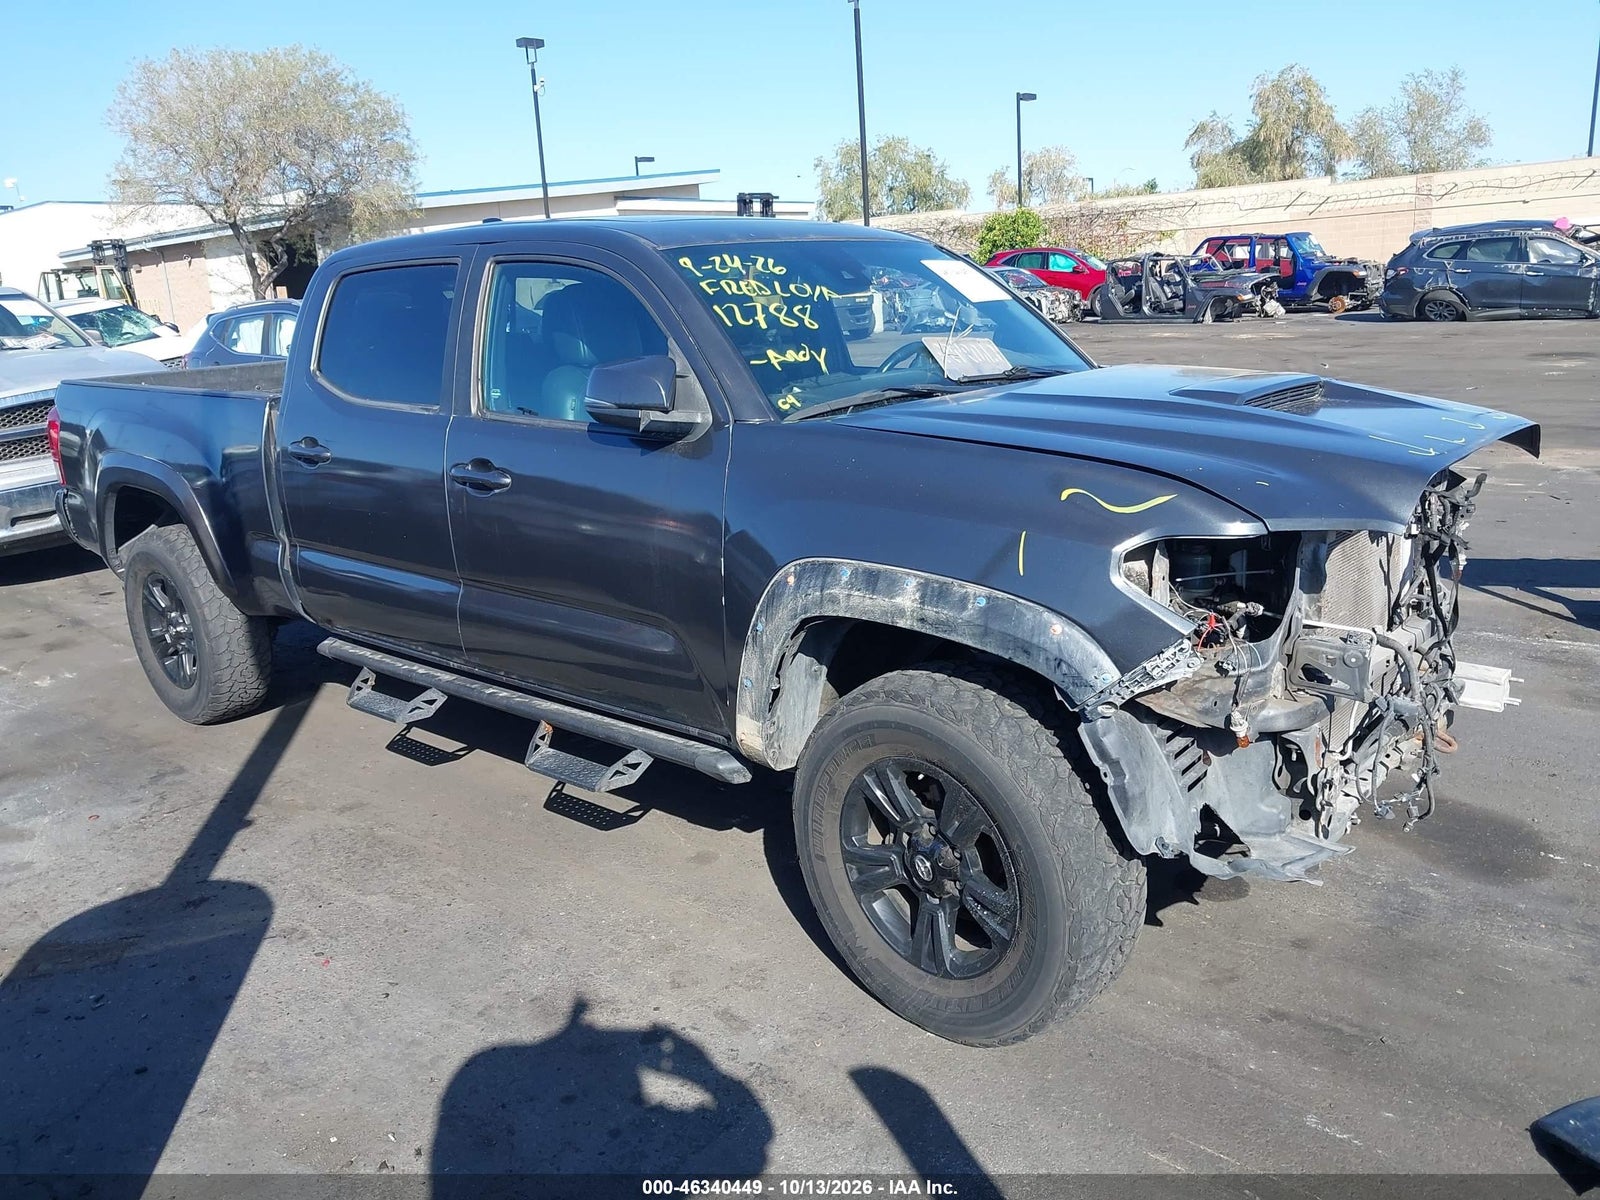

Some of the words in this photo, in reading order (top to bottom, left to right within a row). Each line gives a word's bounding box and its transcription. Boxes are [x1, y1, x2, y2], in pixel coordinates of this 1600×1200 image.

[678, 254, 787, 277] 9-24-26
[699, 279, 772, 297] FRED
[712, 302, 819, 330] 12788
